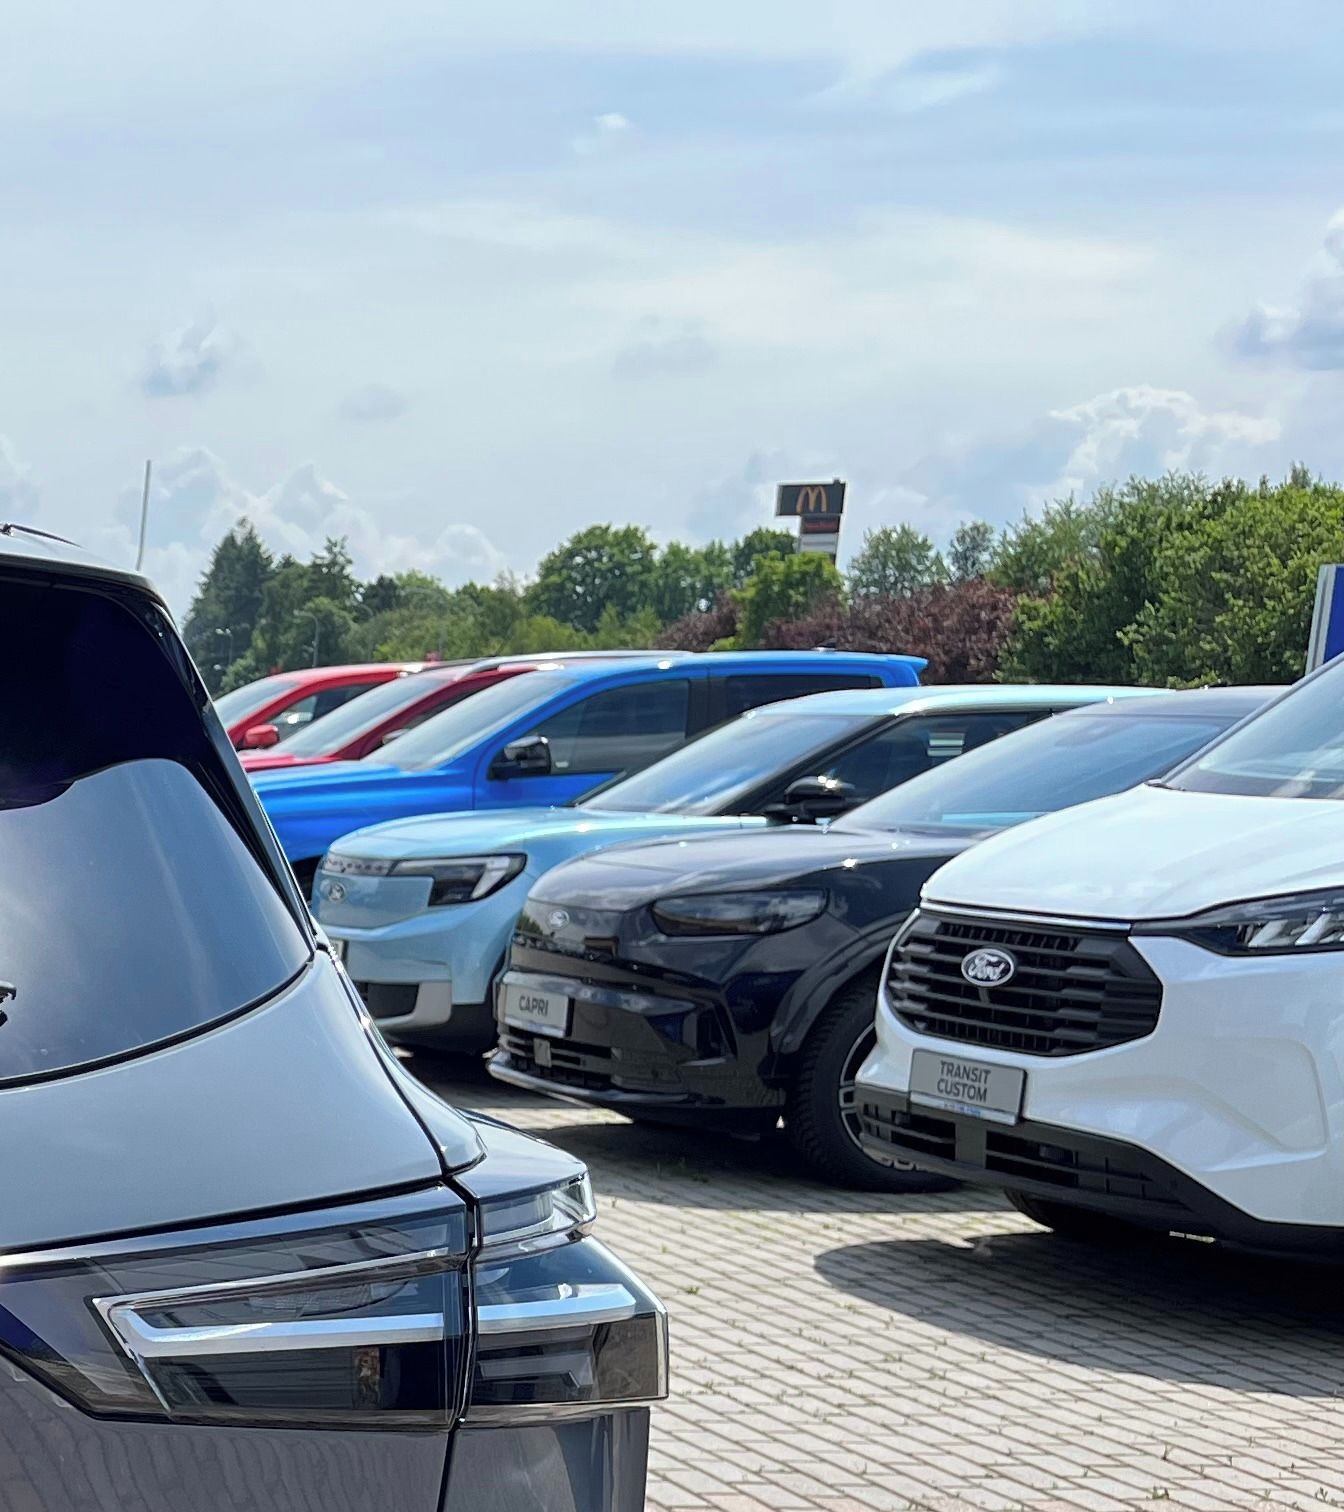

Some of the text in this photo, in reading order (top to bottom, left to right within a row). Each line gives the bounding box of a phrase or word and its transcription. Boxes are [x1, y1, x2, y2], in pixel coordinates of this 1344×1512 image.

[518, 995, 549, 1017] CAPRI
[940, 1060, 991, 1084] TRANSIT
[937, 1078, 988, 1103] CUSTOM
